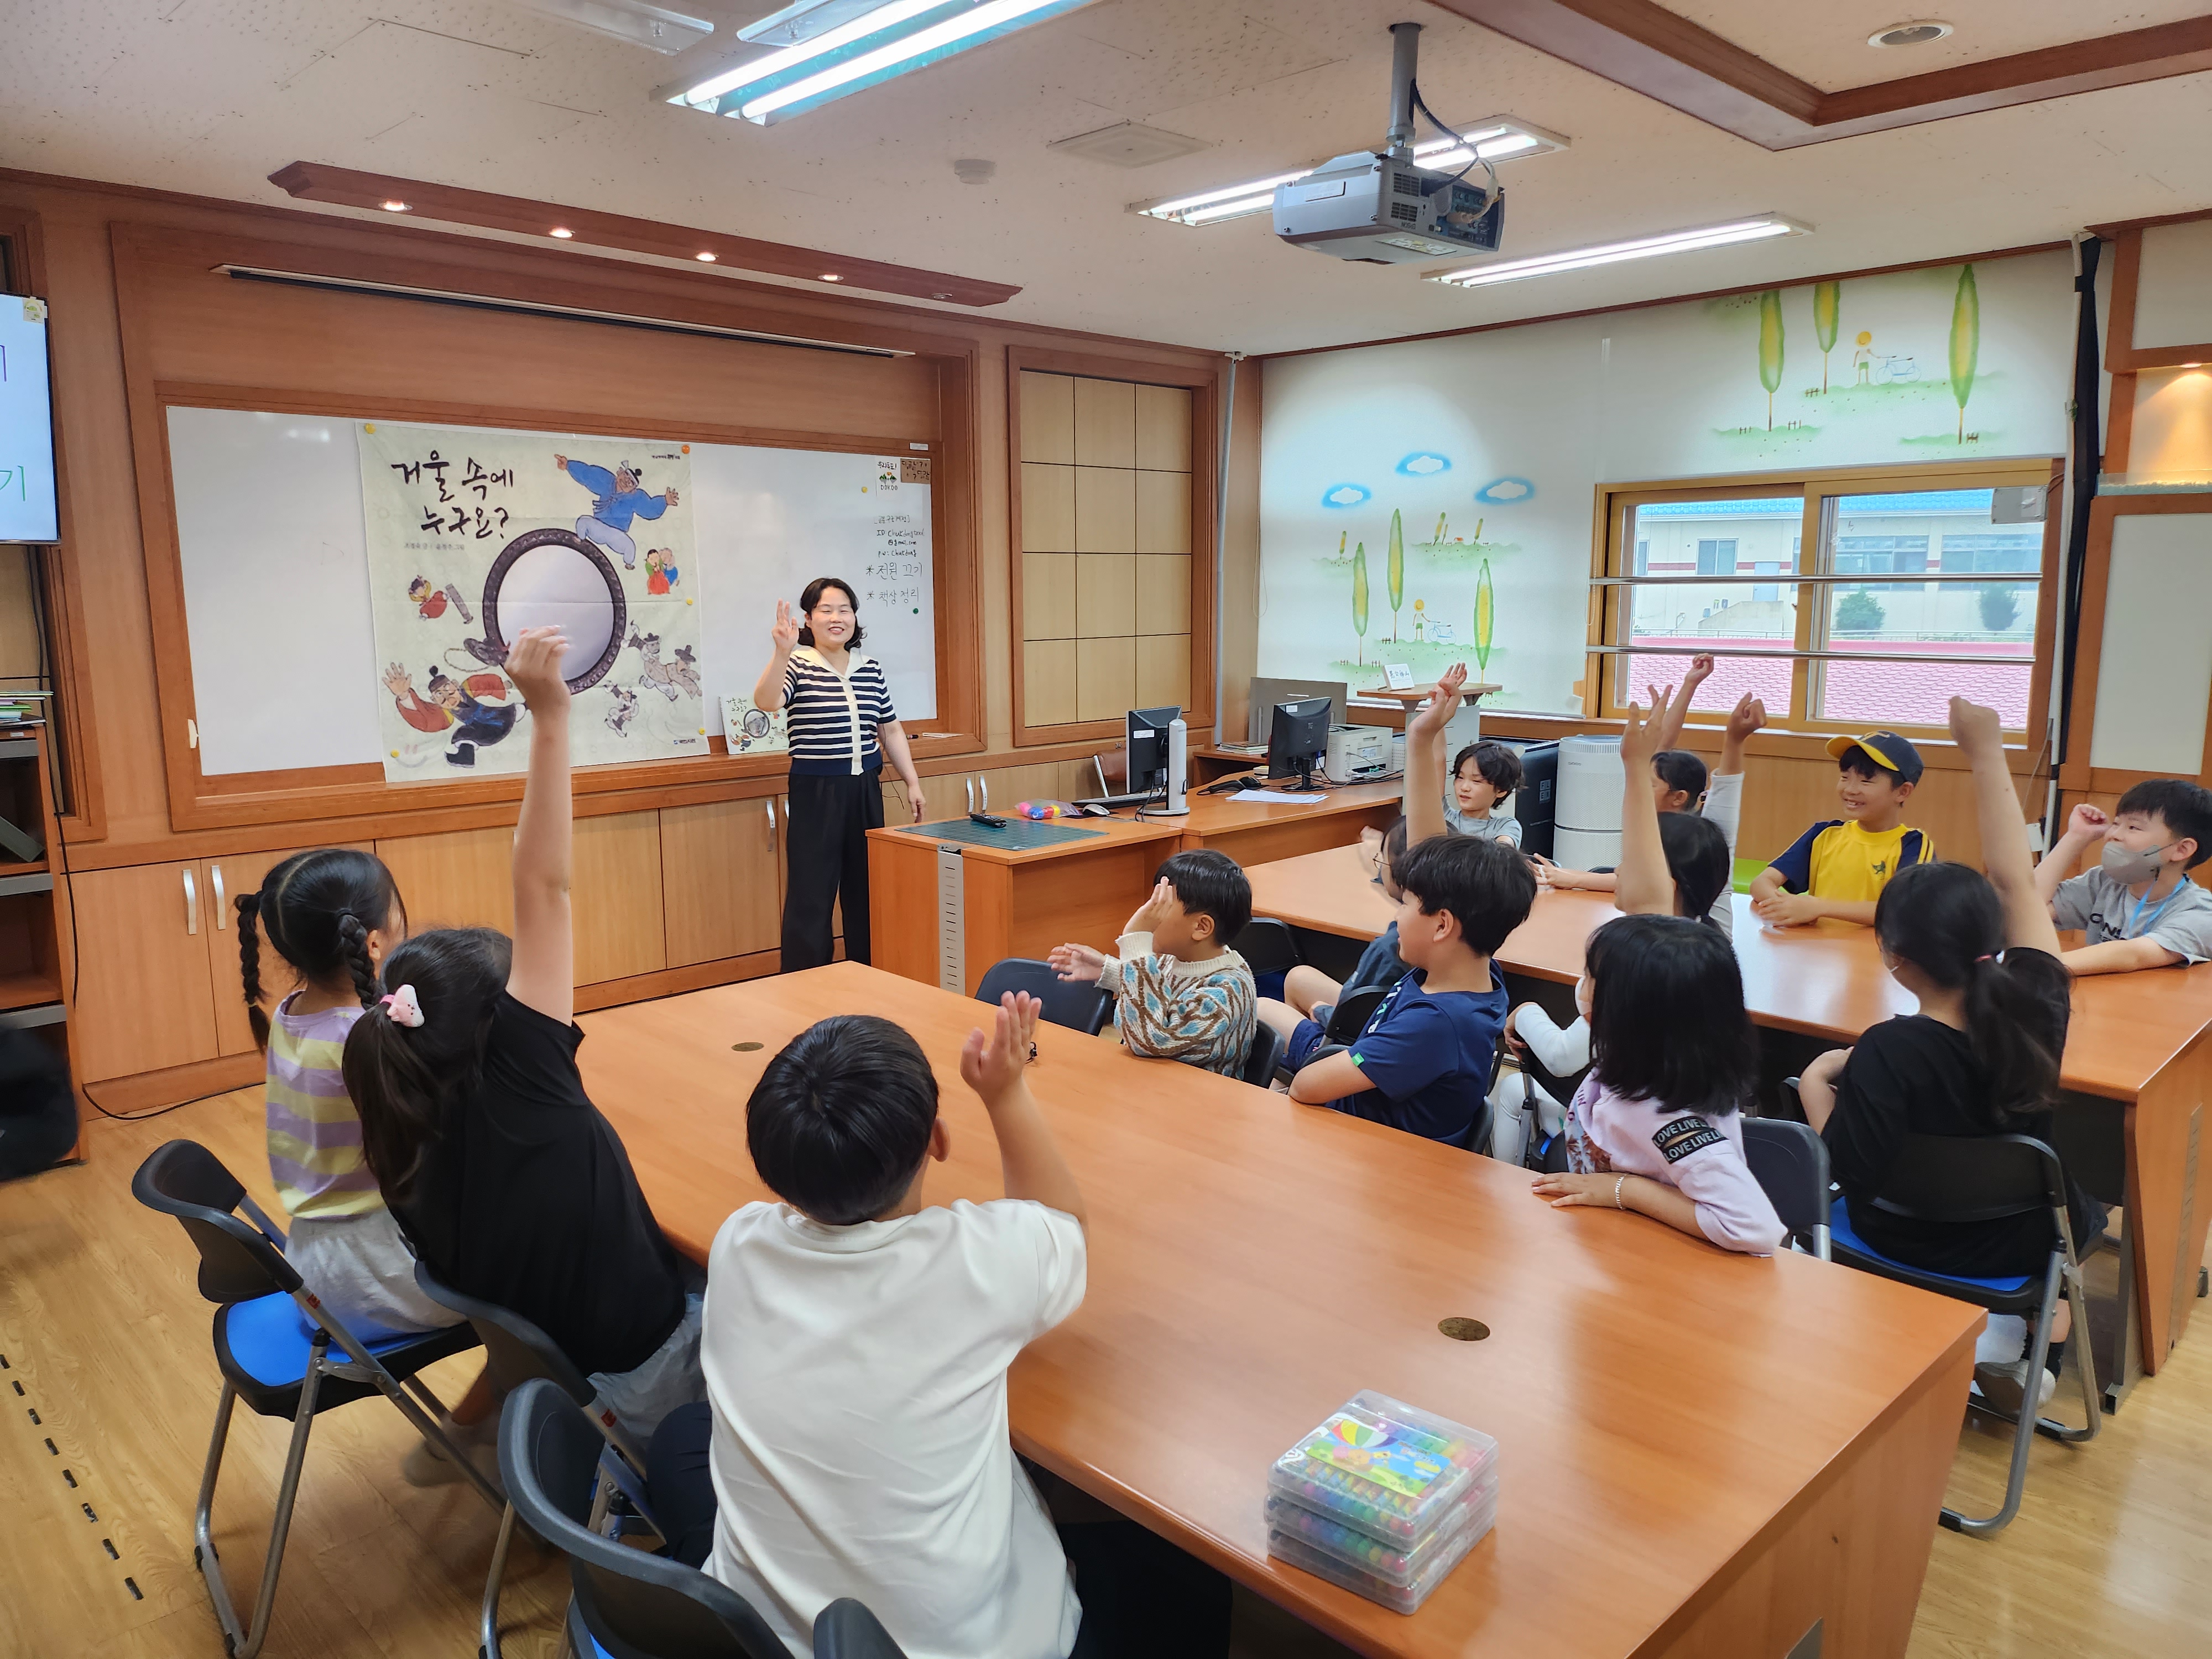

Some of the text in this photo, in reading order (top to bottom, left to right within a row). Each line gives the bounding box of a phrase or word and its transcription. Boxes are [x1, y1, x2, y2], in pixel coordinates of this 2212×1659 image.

[391, 450, 513, 502] 거울 속에
[421, 505, 509, 539] 누구요?
[876, 562, 922, 580] 전원 끄기
[879, 587, 919, 607] 책상 정리
[1663, 1140, 1692, 1162] LOVE
